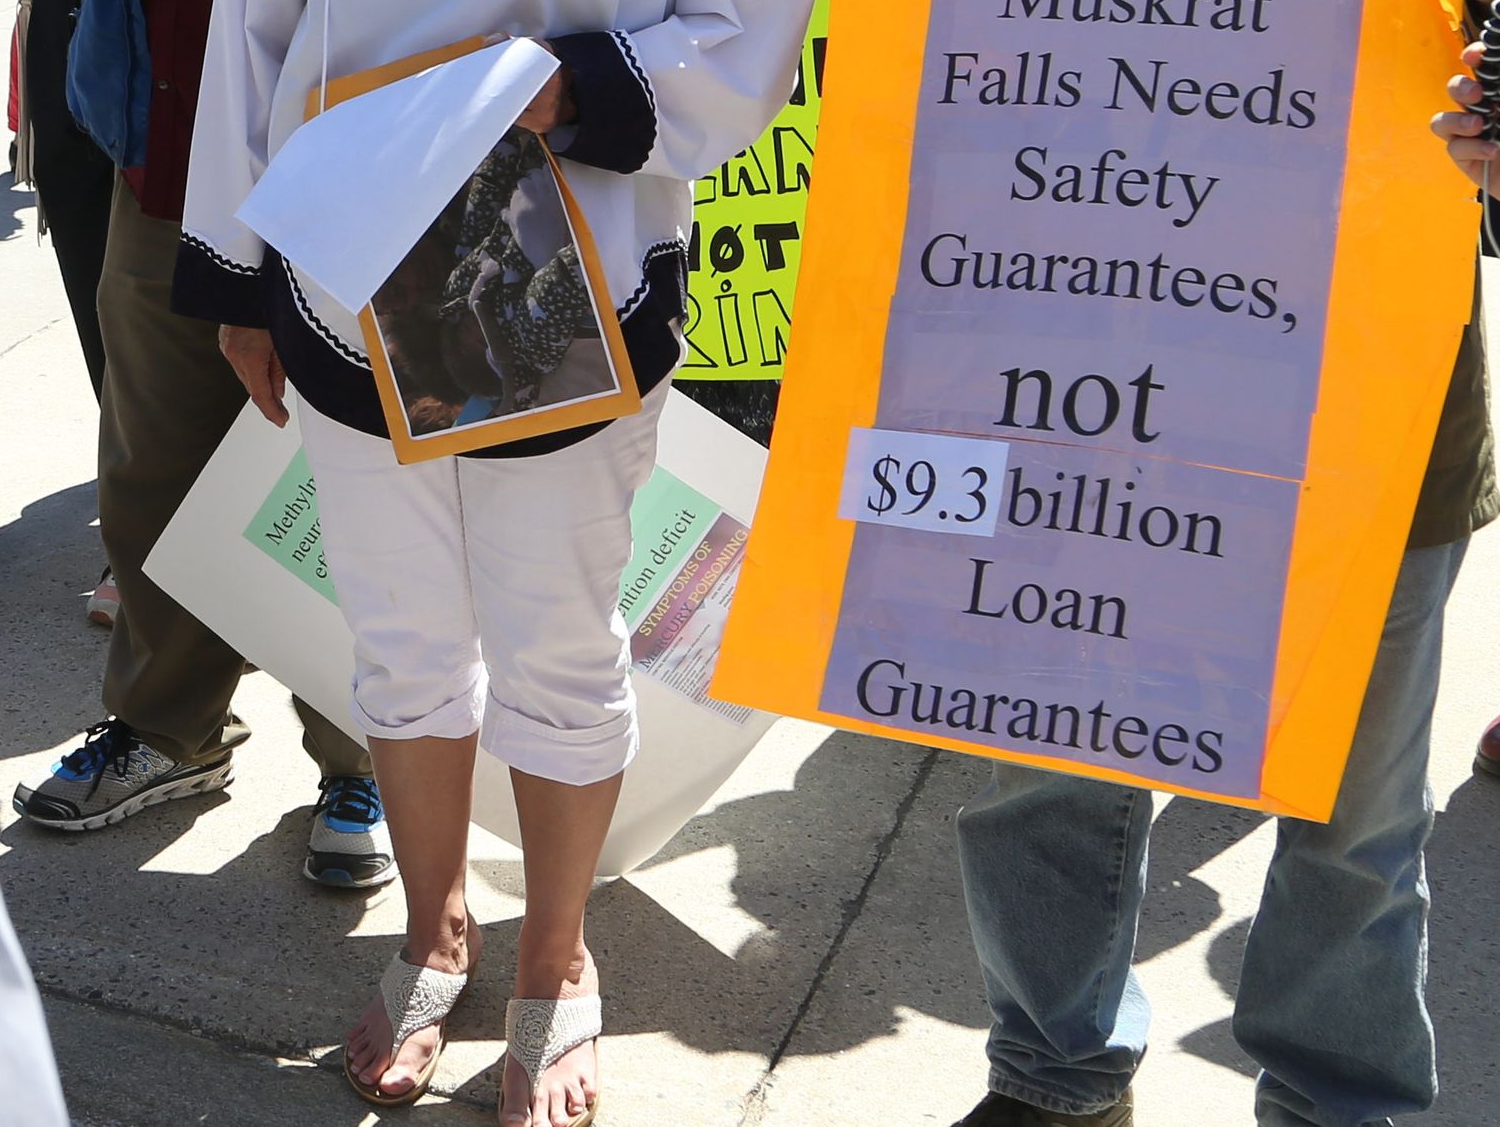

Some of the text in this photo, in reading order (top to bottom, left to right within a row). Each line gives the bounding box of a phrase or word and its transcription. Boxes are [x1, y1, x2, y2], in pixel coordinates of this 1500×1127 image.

[935, 50, 1318, 130] Falls Needs
[1009, 145, 1221, 229] Safety
[919, 232, 1298, 335] Guarantees,
[991, 362, 1166, 446] not
[650, 508, 697, 566] deficit
[866, 453, 1225, 559] $9.3 billion
[638, 559, 700, 637] SYMPTOMS
[694, 540, 713, 561] OF
[638, 601, 694, 669] MERCURY
[688, 529, 749, 605] POISONING
[963, 557, 1130, 641] Loan
[854, 658, 1225, 778] Guarantees
